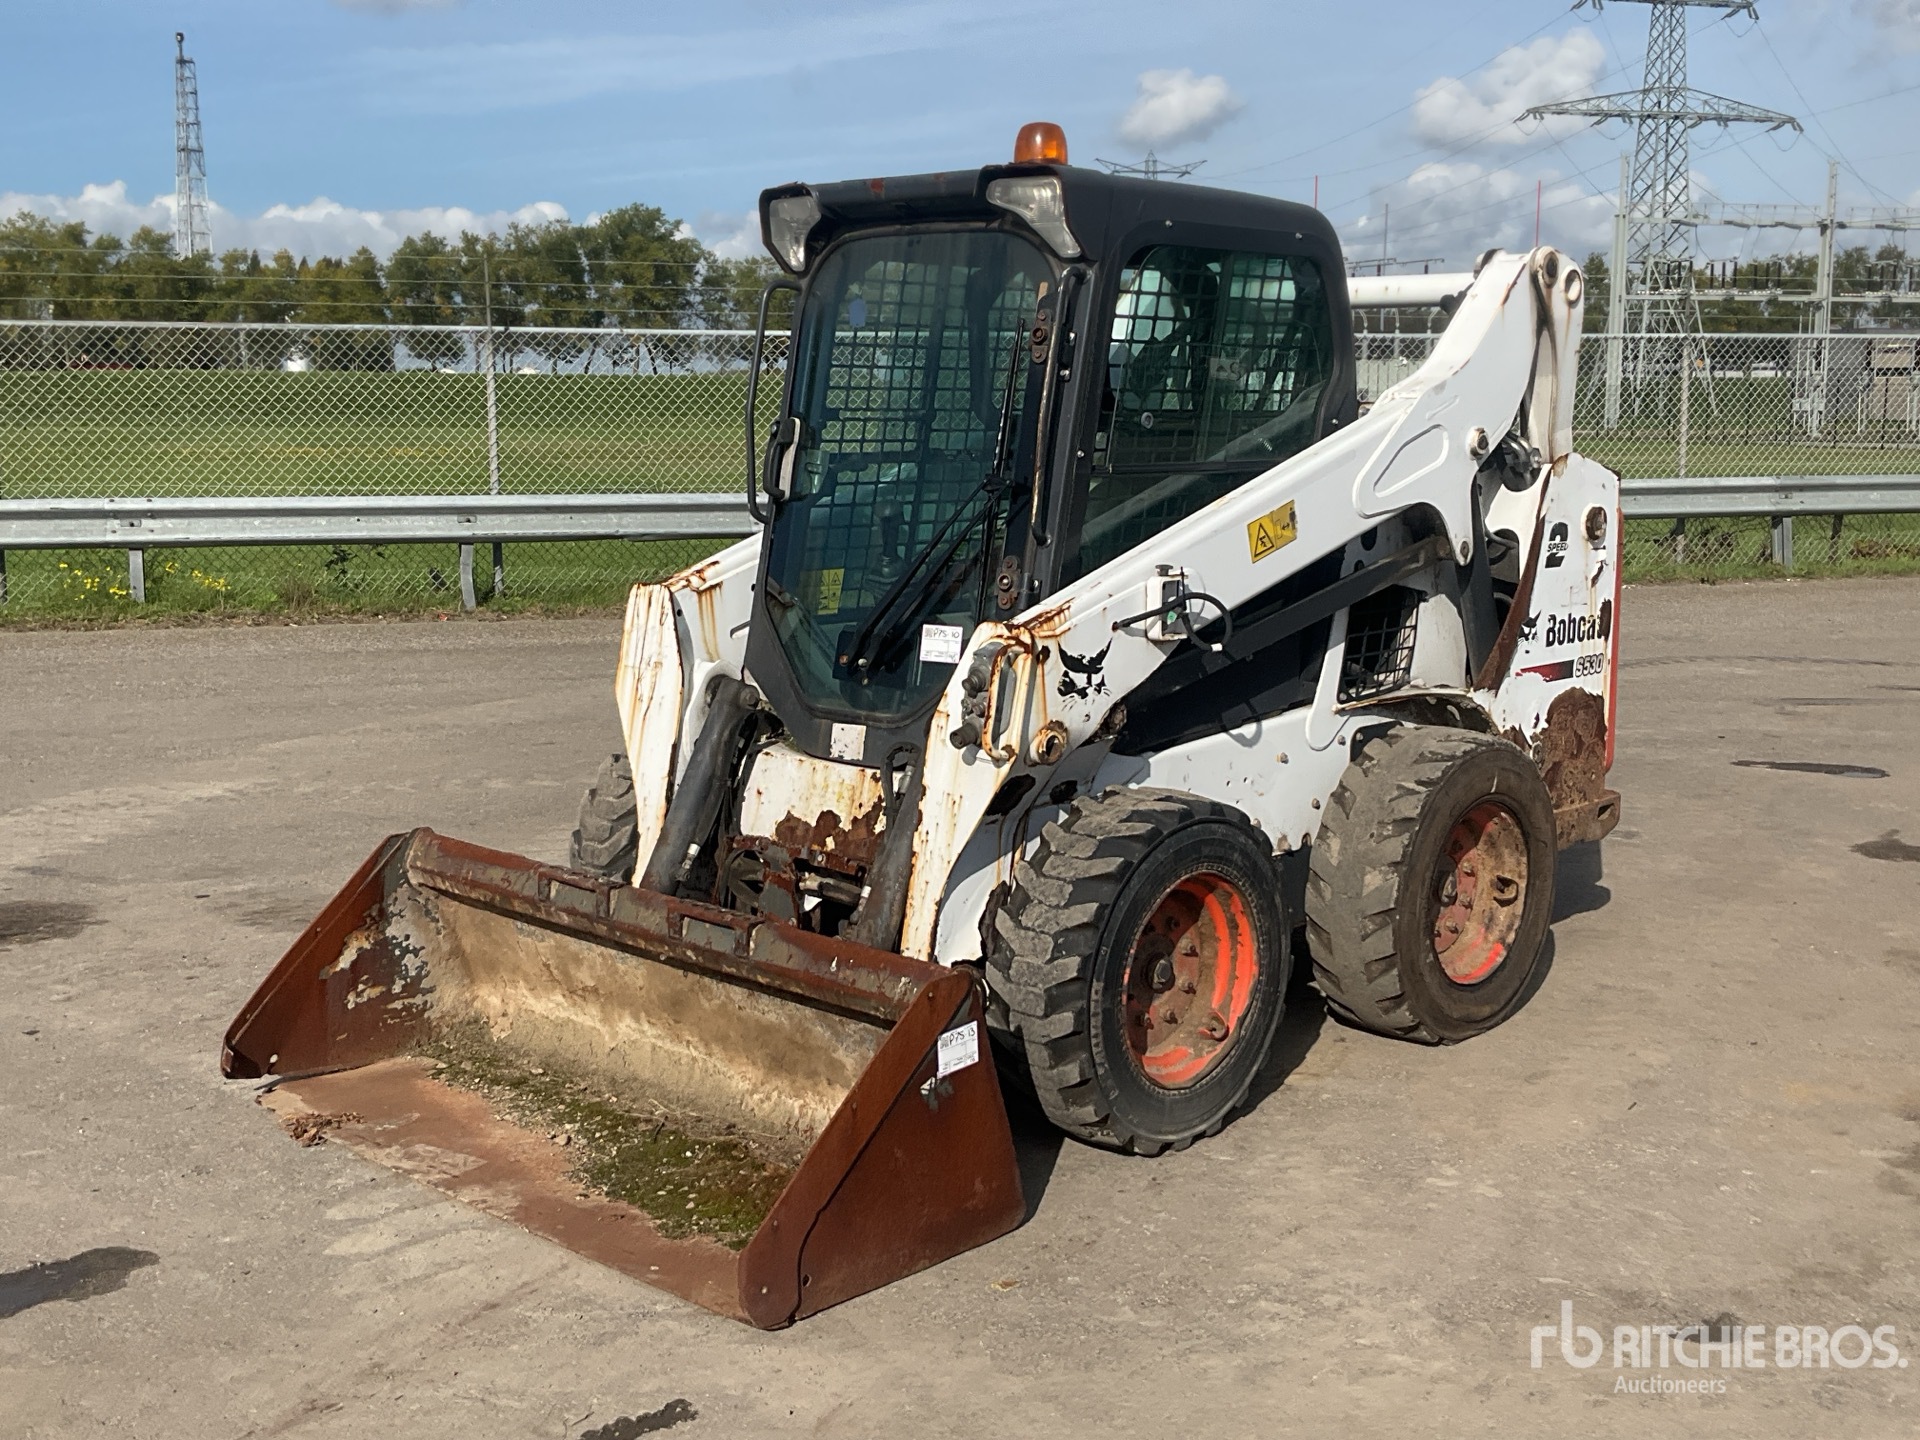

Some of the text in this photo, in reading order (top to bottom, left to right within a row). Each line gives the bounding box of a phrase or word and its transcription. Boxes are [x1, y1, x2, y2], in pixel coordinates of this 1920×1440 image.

[1545, 522, 1568, 568] 2
[1547, 542, 1568, 552] SPEED
[1575, 653, 1604, 678] S530
